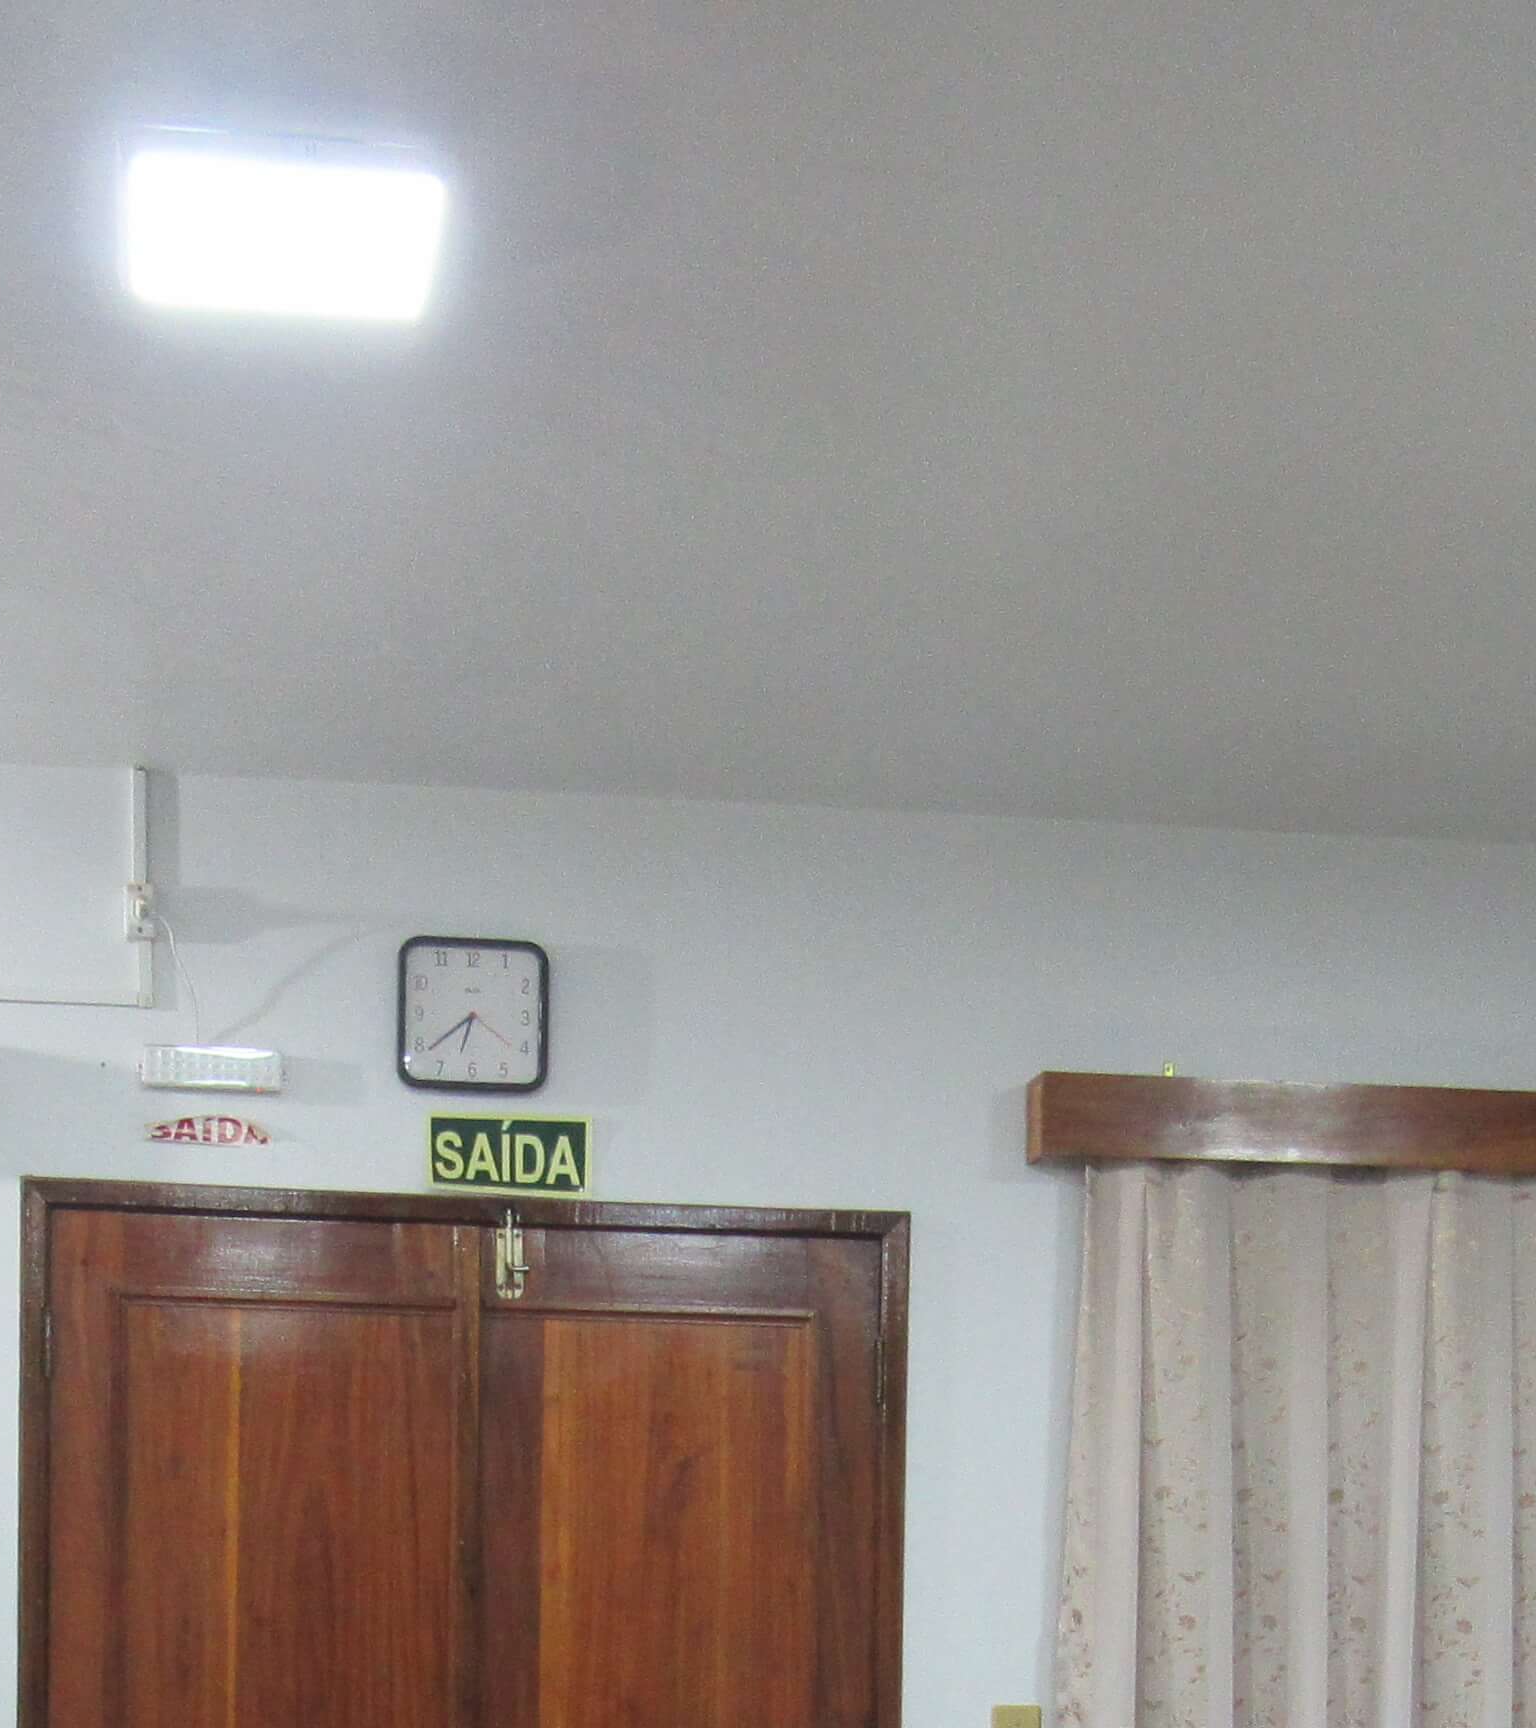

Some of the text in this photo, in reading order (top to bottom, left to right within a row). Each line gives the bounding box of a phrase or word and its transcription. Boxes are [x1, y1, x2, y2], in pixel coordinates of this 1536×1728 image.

[434, 951, 448, 967] 11
[466, 951, 481, 968] 12
[502, 953, 509, 969] 1
[415, 975, 429, 991] 10
[521, 977, 530, 995] 2
[415, 1006, 424, 1022] 9
[520, 1009, 530, 1026] 3
[414, 1036, 425, 1052] 8
[520, 1040, 529, 1055] 4
[436, 1060, 445, 1076] 7
[468, 1062, 477, 1078] 6
[499, 1062, 508, 1077] 5
[434, 1120, 581, 1186] SAÍDA
